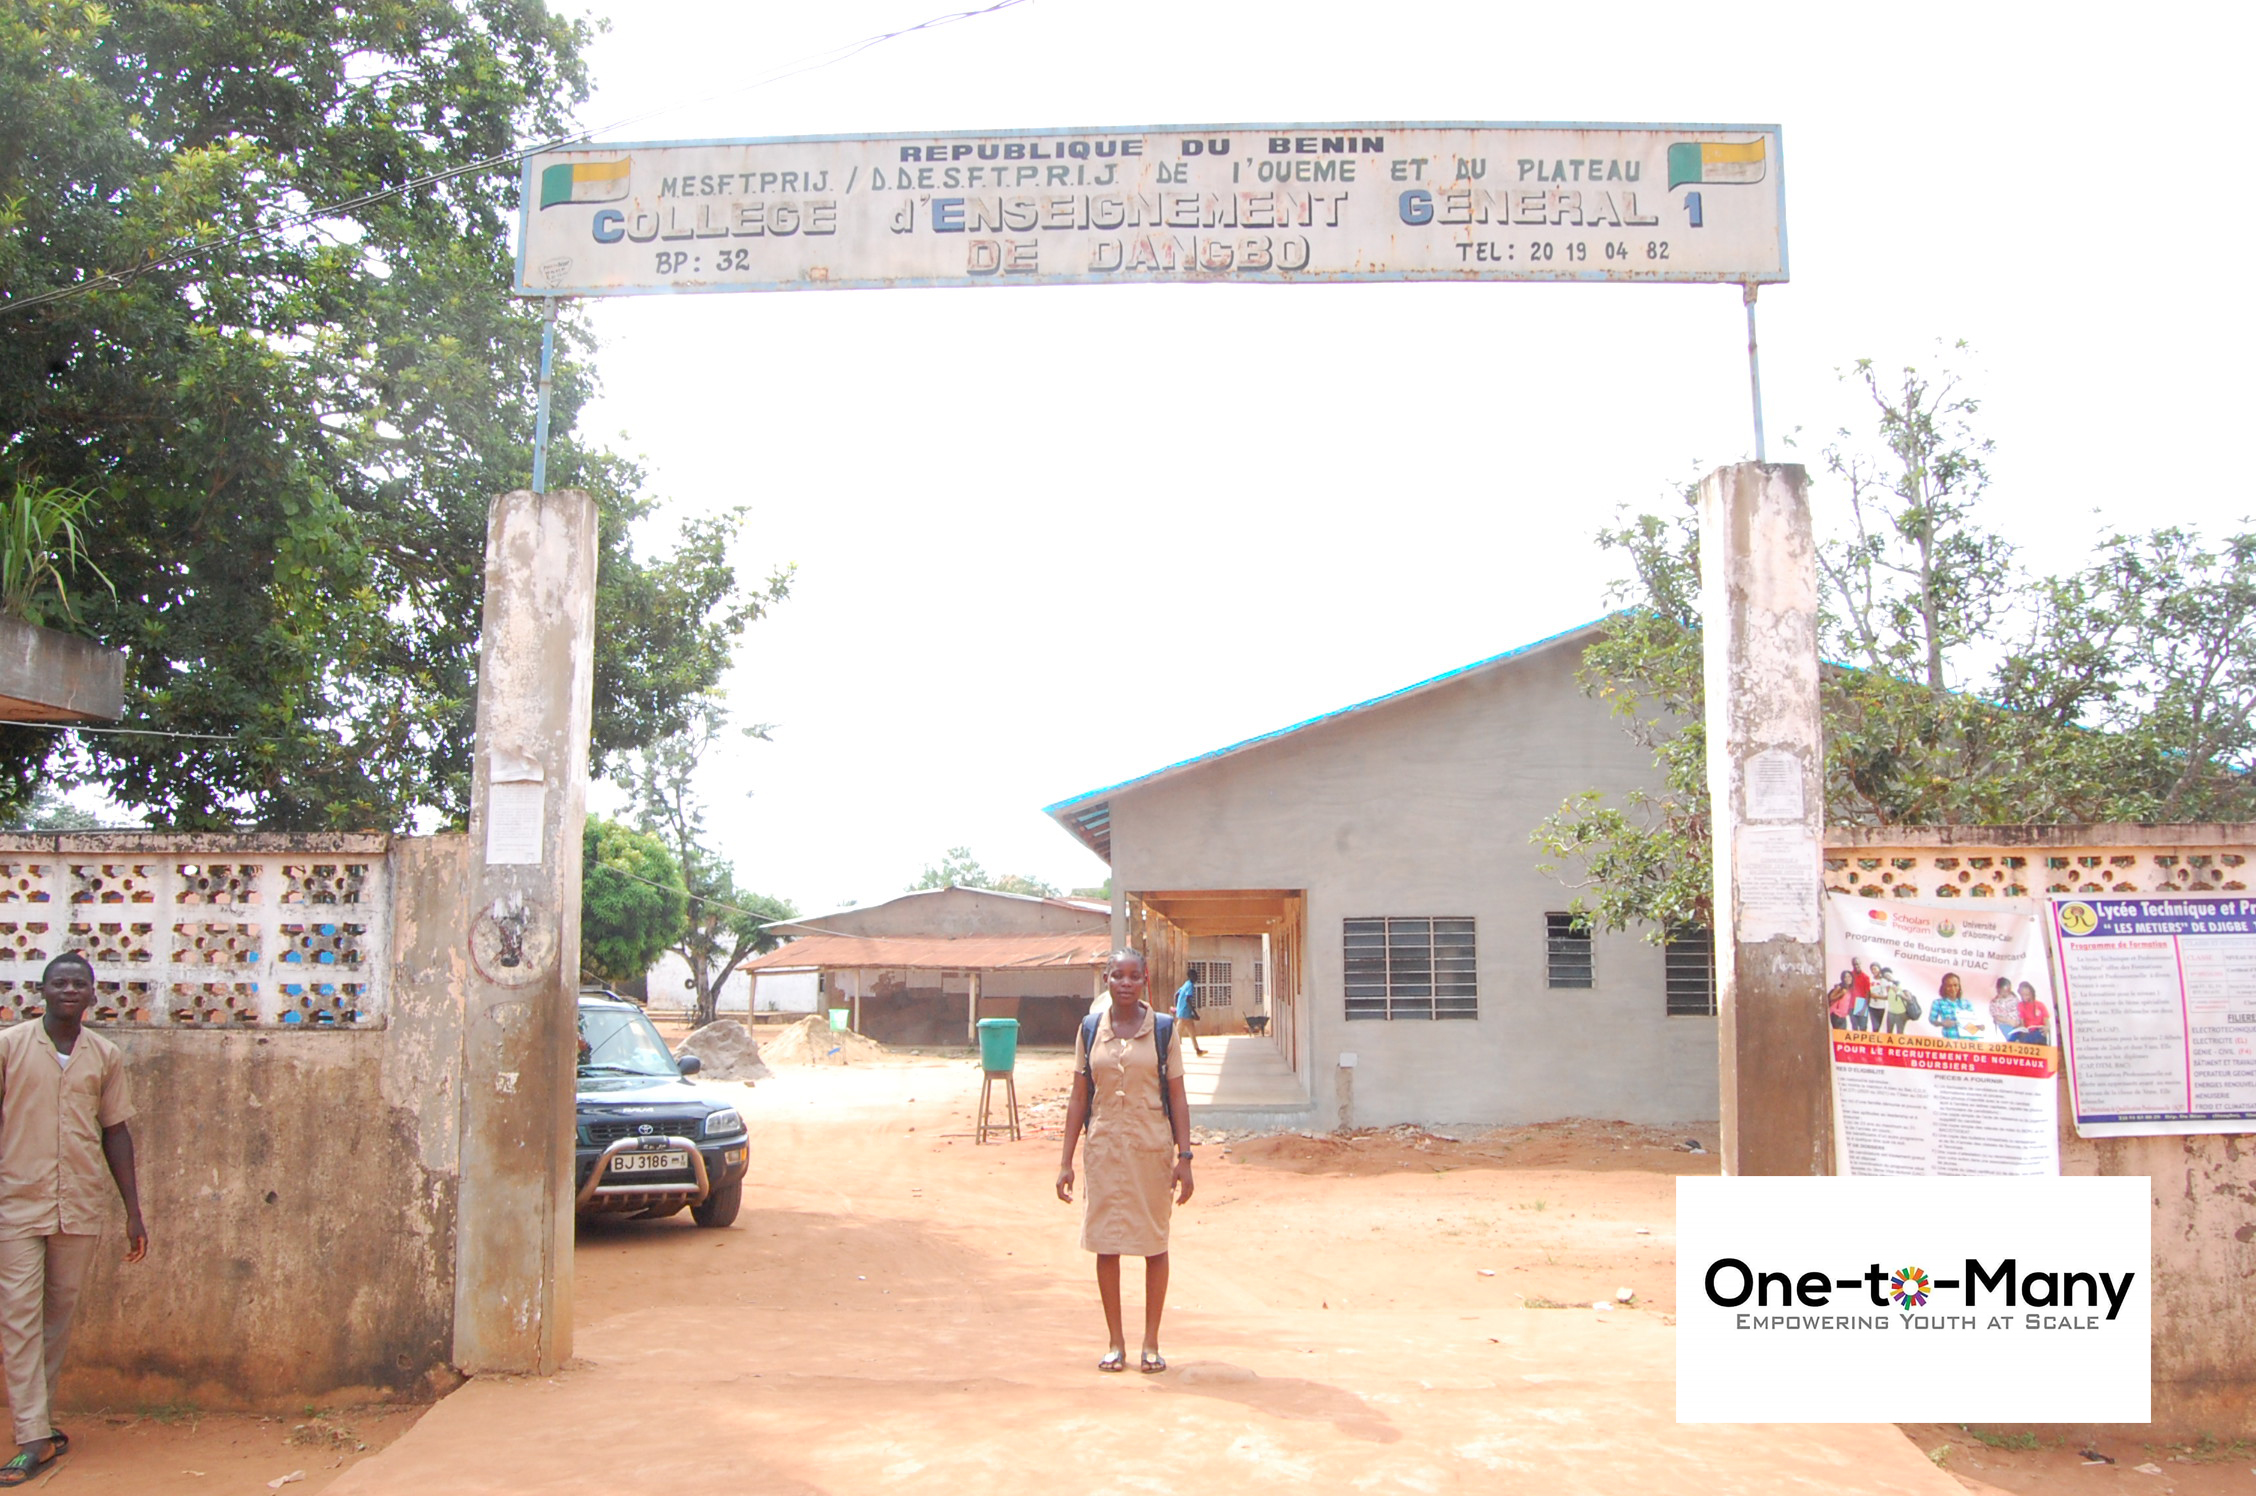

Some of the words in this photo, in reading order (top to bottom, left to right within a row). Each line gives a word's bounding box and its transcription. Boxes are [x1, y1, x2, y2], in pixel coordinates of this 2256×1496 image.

[900, 139, 1143, 162] REPUBLIQUE
[1181, 138, 1230, 156] DU
[1268, 136, 1384, 154] BENIN
[1156, 161, 1188, 184] DE
[1390, 159, 1428, 181] ET
[1456, 158, 1486, 180] DU
[1518, 158, 1640, 182] PLATEAU
[592, 200, 836, 244] COLLEGE
[1398, 188, 1659, 227] GENERAL
[1683, 190, 1704, 228] 1
[655, 252, 700, 274] BP:
[716, 248, 750, 272] 32
[966, 238, 1039, 275] DE
[1088, 234, 1310, 273] DANGBO
[1456, 242, 1515, 262] TEL:
[1530, 242, 1553, 261] 20
[1565, 242, 1587, 261] 19
[1604, 241, 1629, 260] 04
[1646, 241, 1670, 260] 82
[1892, 912, 1930, 926] Scholars
[2096, 901, 2137, 920] Lycée
[2140, 900, 2216, 919] Technique
[2220, 901, 2235, 916] et
[1892, 922, 1931, 935] Program
[1962, 920, 1996, 931] Université
[2114, 923, 2133, 934] LES
[2191, 922, 2207, 932] DE
[2208, 921, 2249, 932] DJIGBE
[1845, 931, 1901, 946] Programme
[1903, 941, 1915, 949] de
[1918, 942, 1958, 955] Bourses
[1961, 948, 1974, 956] de
[1976, 950, 1984, 958] la
[2070, 942, 2116, 951] Programme
[2118, 941, 2127, 949] de
[1894, 949, 1950, 965] Foundation
[1844, 1033, 1883, 1043] APPEL
[1898, 1037, 1985, 1051] CANDIDATURE
[1989, 1043, 2041, 1056] 2021-2022
[1837, 1044, 1867, 1054] POUR
[1870, 1046, 1883, 1055] LE
[1888, 1048, 1969, 1061] RECRUTEMENT
[1973, 1055, 1987, 1063] DE
[1991, 1056, 2045, 1068] NOUVEAUX
[1910, 1059, 1975, 1071] BOURSIERS
[614, 1156, 634, 1171] BJ
[638, 1155, 668, 1169] 3186
